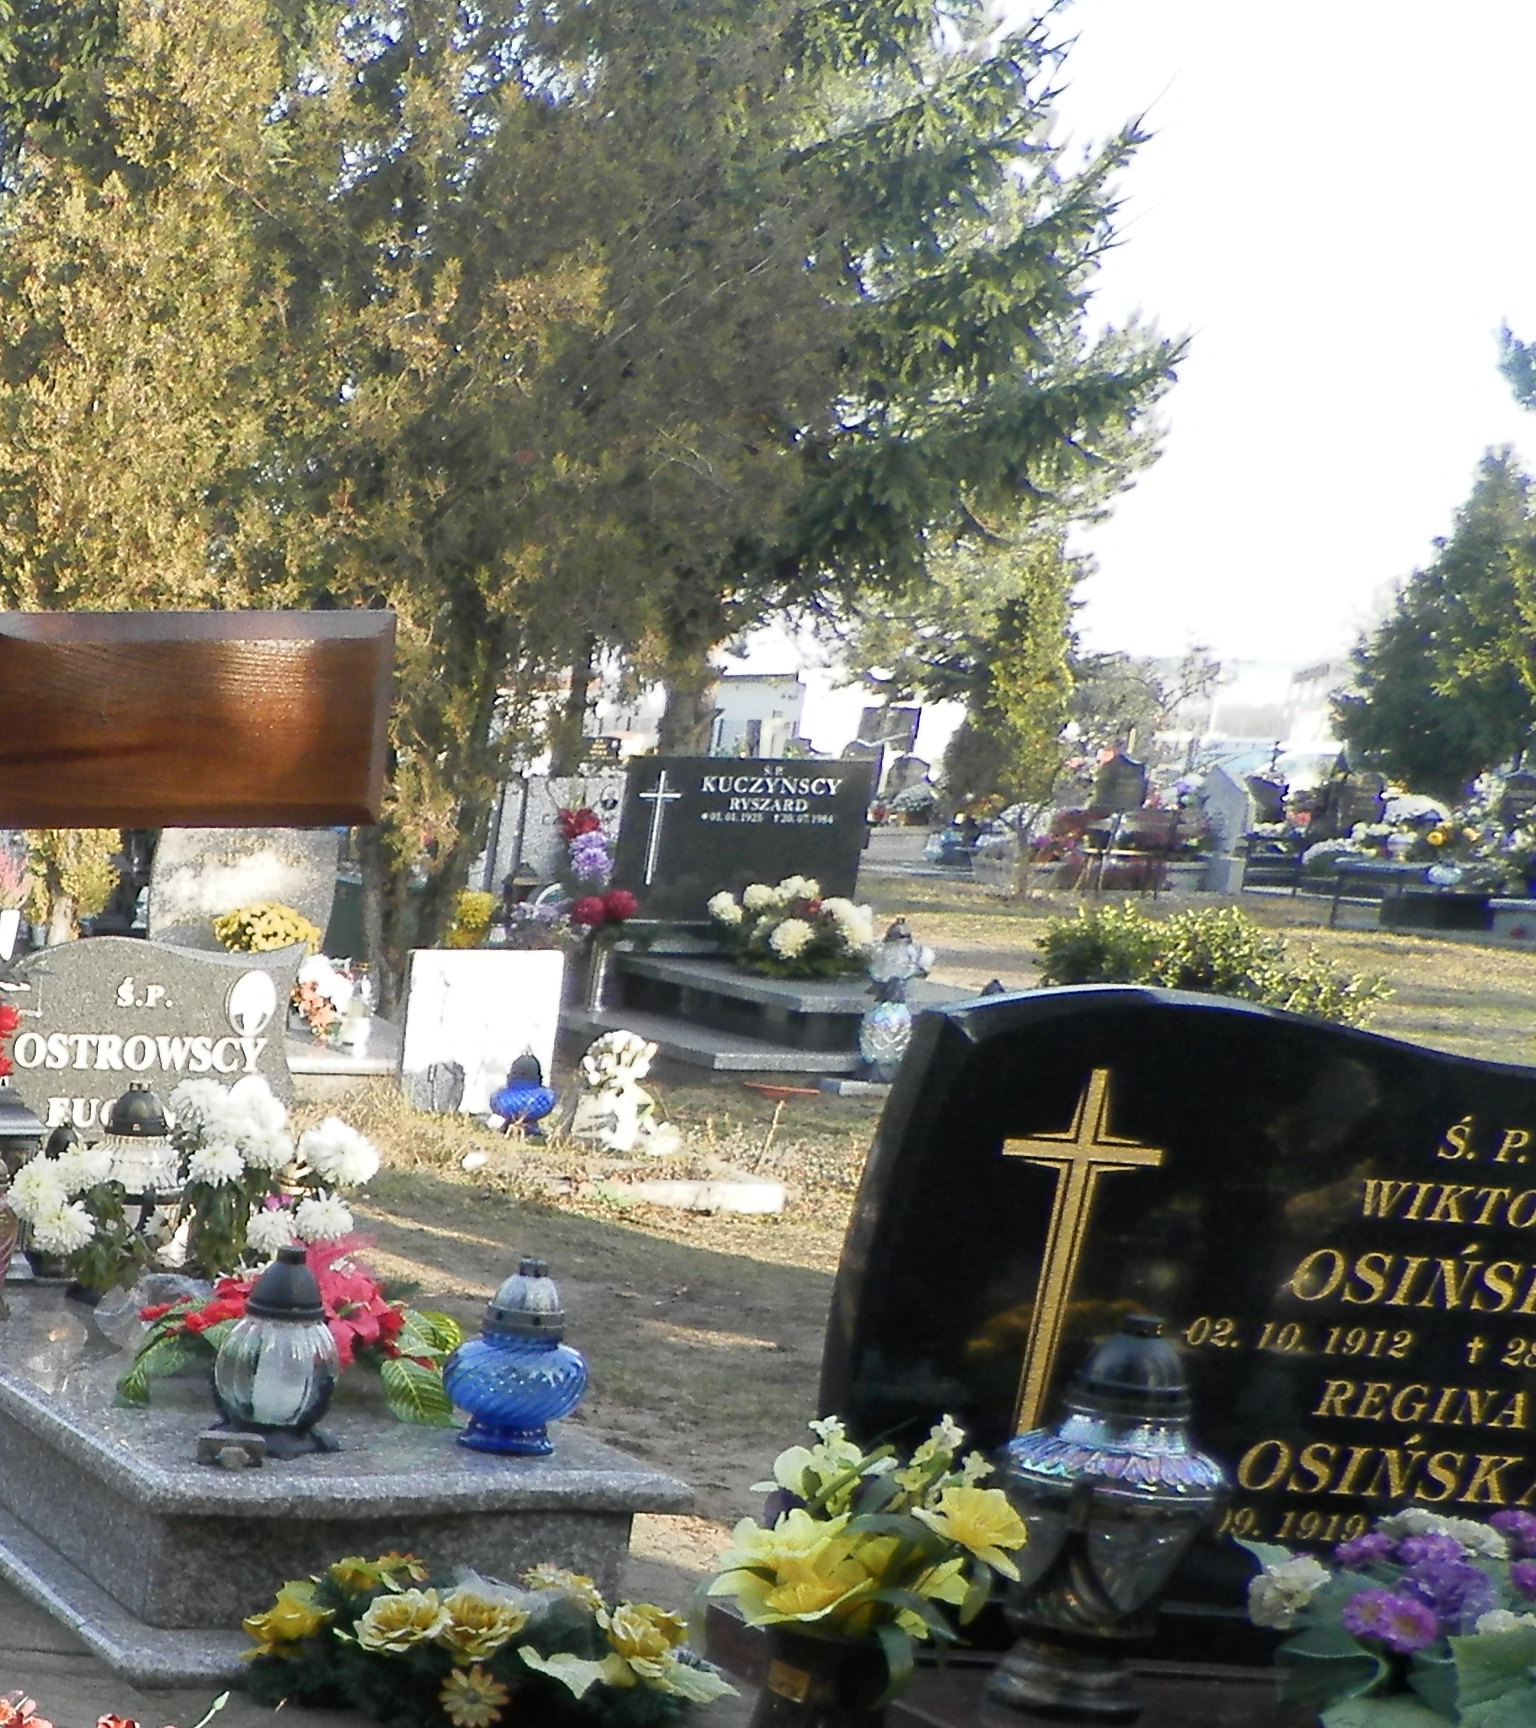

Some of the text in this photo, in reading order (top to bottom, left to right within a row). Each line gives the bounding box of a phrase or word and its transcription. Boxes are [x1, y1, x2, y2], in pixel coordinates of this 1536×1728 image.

[729, 797, 809, 812] RYSZARD
[115, 976, 174, 1008] Ś.P.
[13, 1031, 269, 1074] OSTROWSCY
[1289, 1243, 1536, 1314] OSIŃS
[1184, 1316, 1239, 1349] 02.
[1256, 1322, 1308, 1352] 10.
[1323, 1326, 1415, 1359] 1912
[1311, 1379, 1529, 1430] REGINA
[1274, 1510, 1367, 1542] 1919
